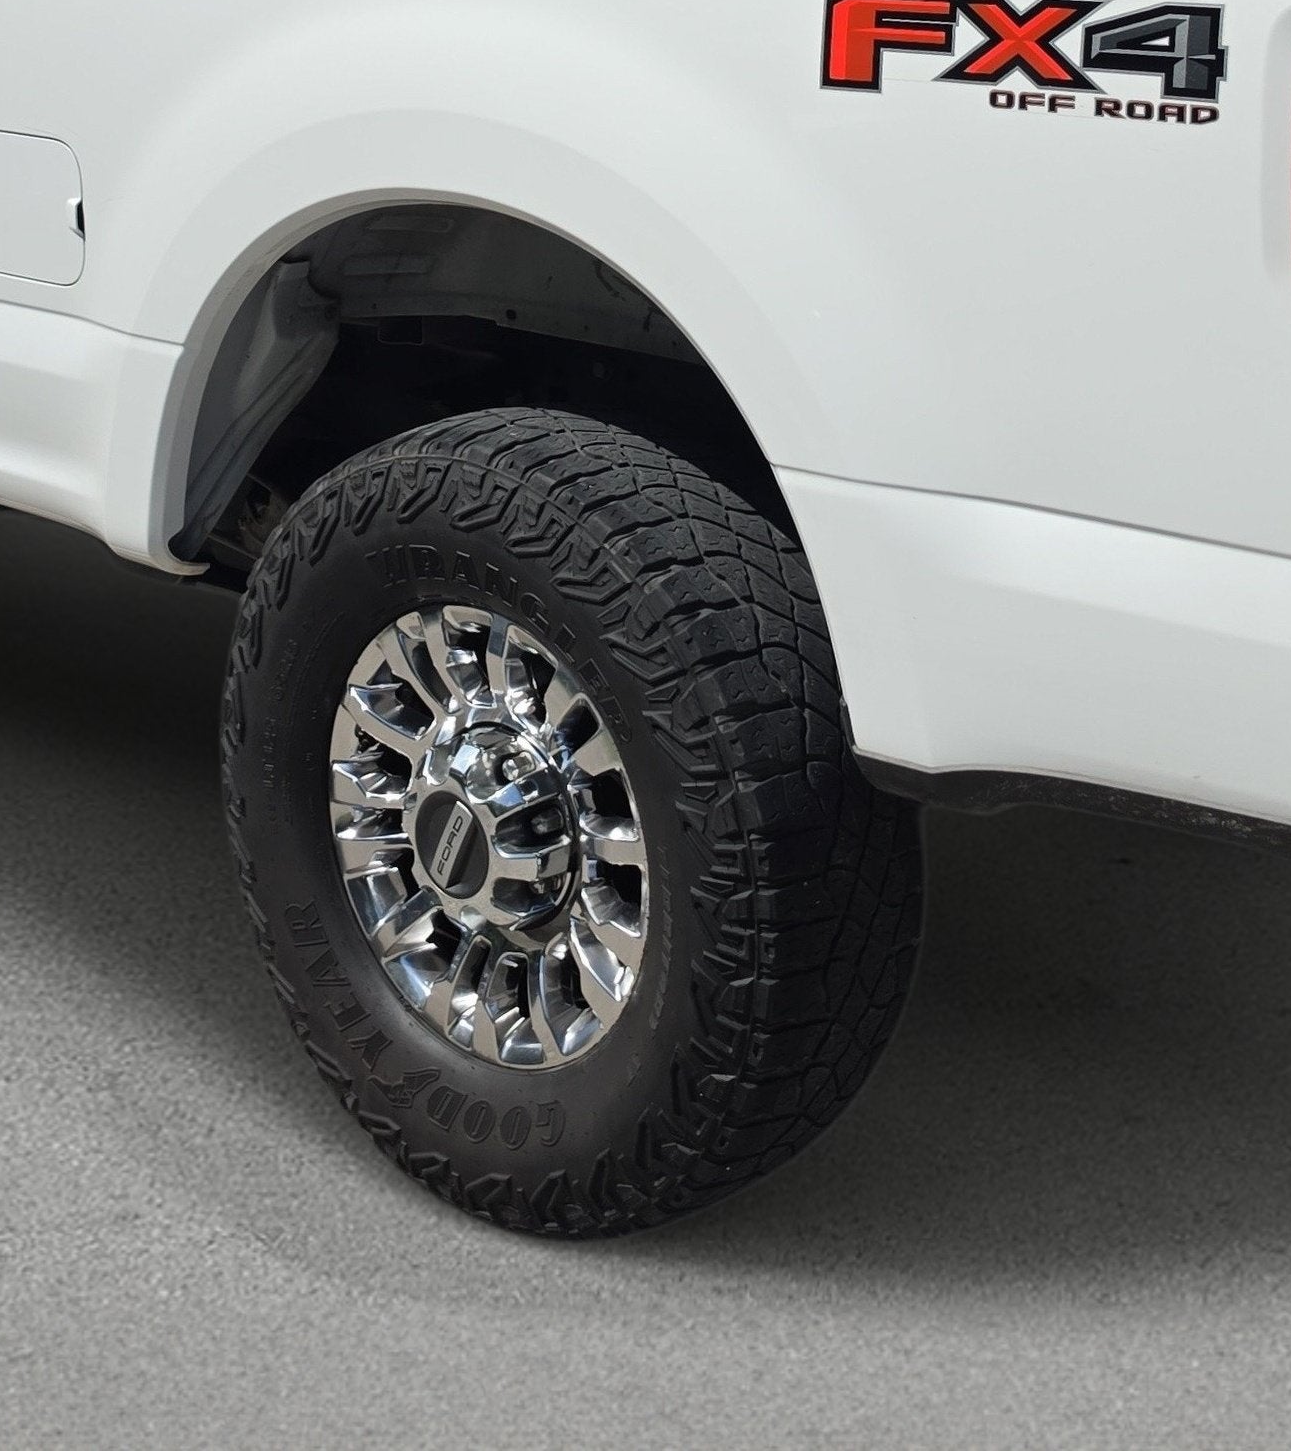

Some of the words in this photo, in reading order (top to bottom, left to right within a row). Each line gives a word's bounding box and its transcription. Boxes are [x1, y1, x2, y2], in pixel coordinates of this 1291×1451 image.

[988, 89, 1077, 114] OFF
[1093, 96, 1221, 126] ROAD
[364, 543, 633, 744] WRANGLER
[436, 815, 464, 877] FORD
